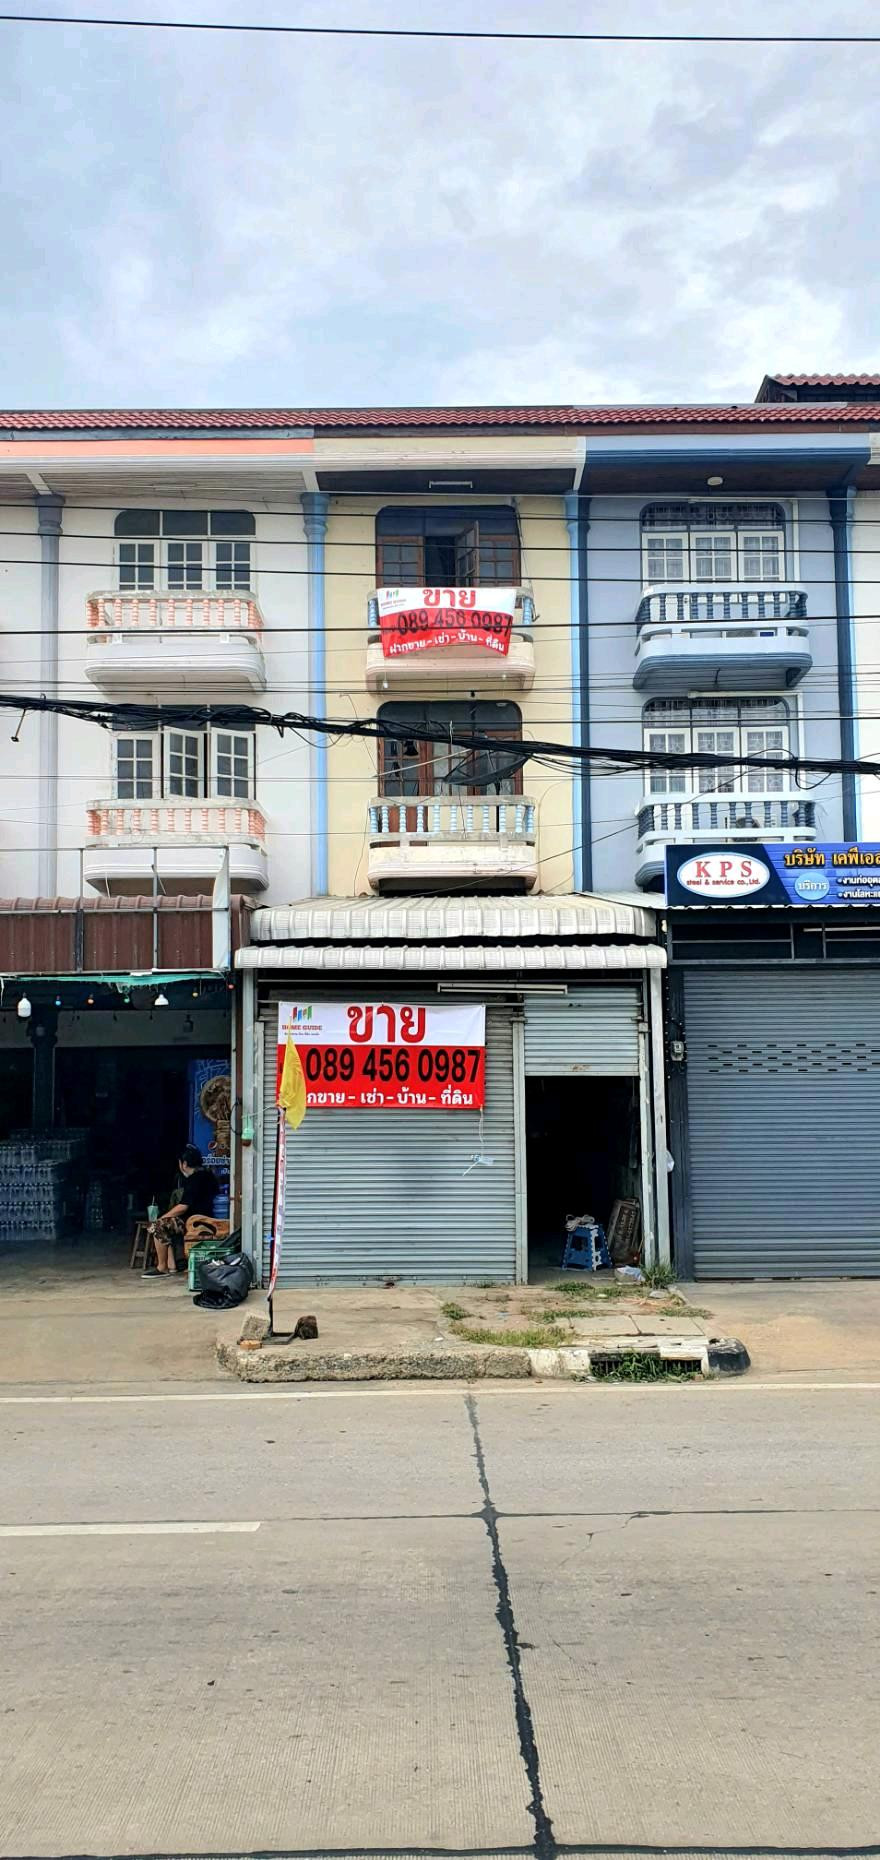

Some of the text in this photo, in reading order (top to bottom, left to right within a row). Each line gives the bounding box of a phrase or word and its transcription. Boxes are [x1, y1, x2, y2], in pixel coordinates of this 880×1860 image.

[422, 588, 476, 608] ขาย
[398, 609, 429, 635] 089
[434, 608, 466, 629] 456
[434, 632, 450, 645] เช่า
[458, 629, 478, 642] บ้าน
[784, 847, 825, 866] บริษัท
[798, 879, 828, 891] บริการ
[347, 1005, 427, 1044] ขาย
[305, 1048, 481, 1083] 089 456 0987
[307, 1092, 345, 1104] กขาย
[360, 1088, 384, 1104] เช่า
[397, 1086, 427, 1104] บ้าน
[440, 1084, 474, 1105] ที่ดิน
